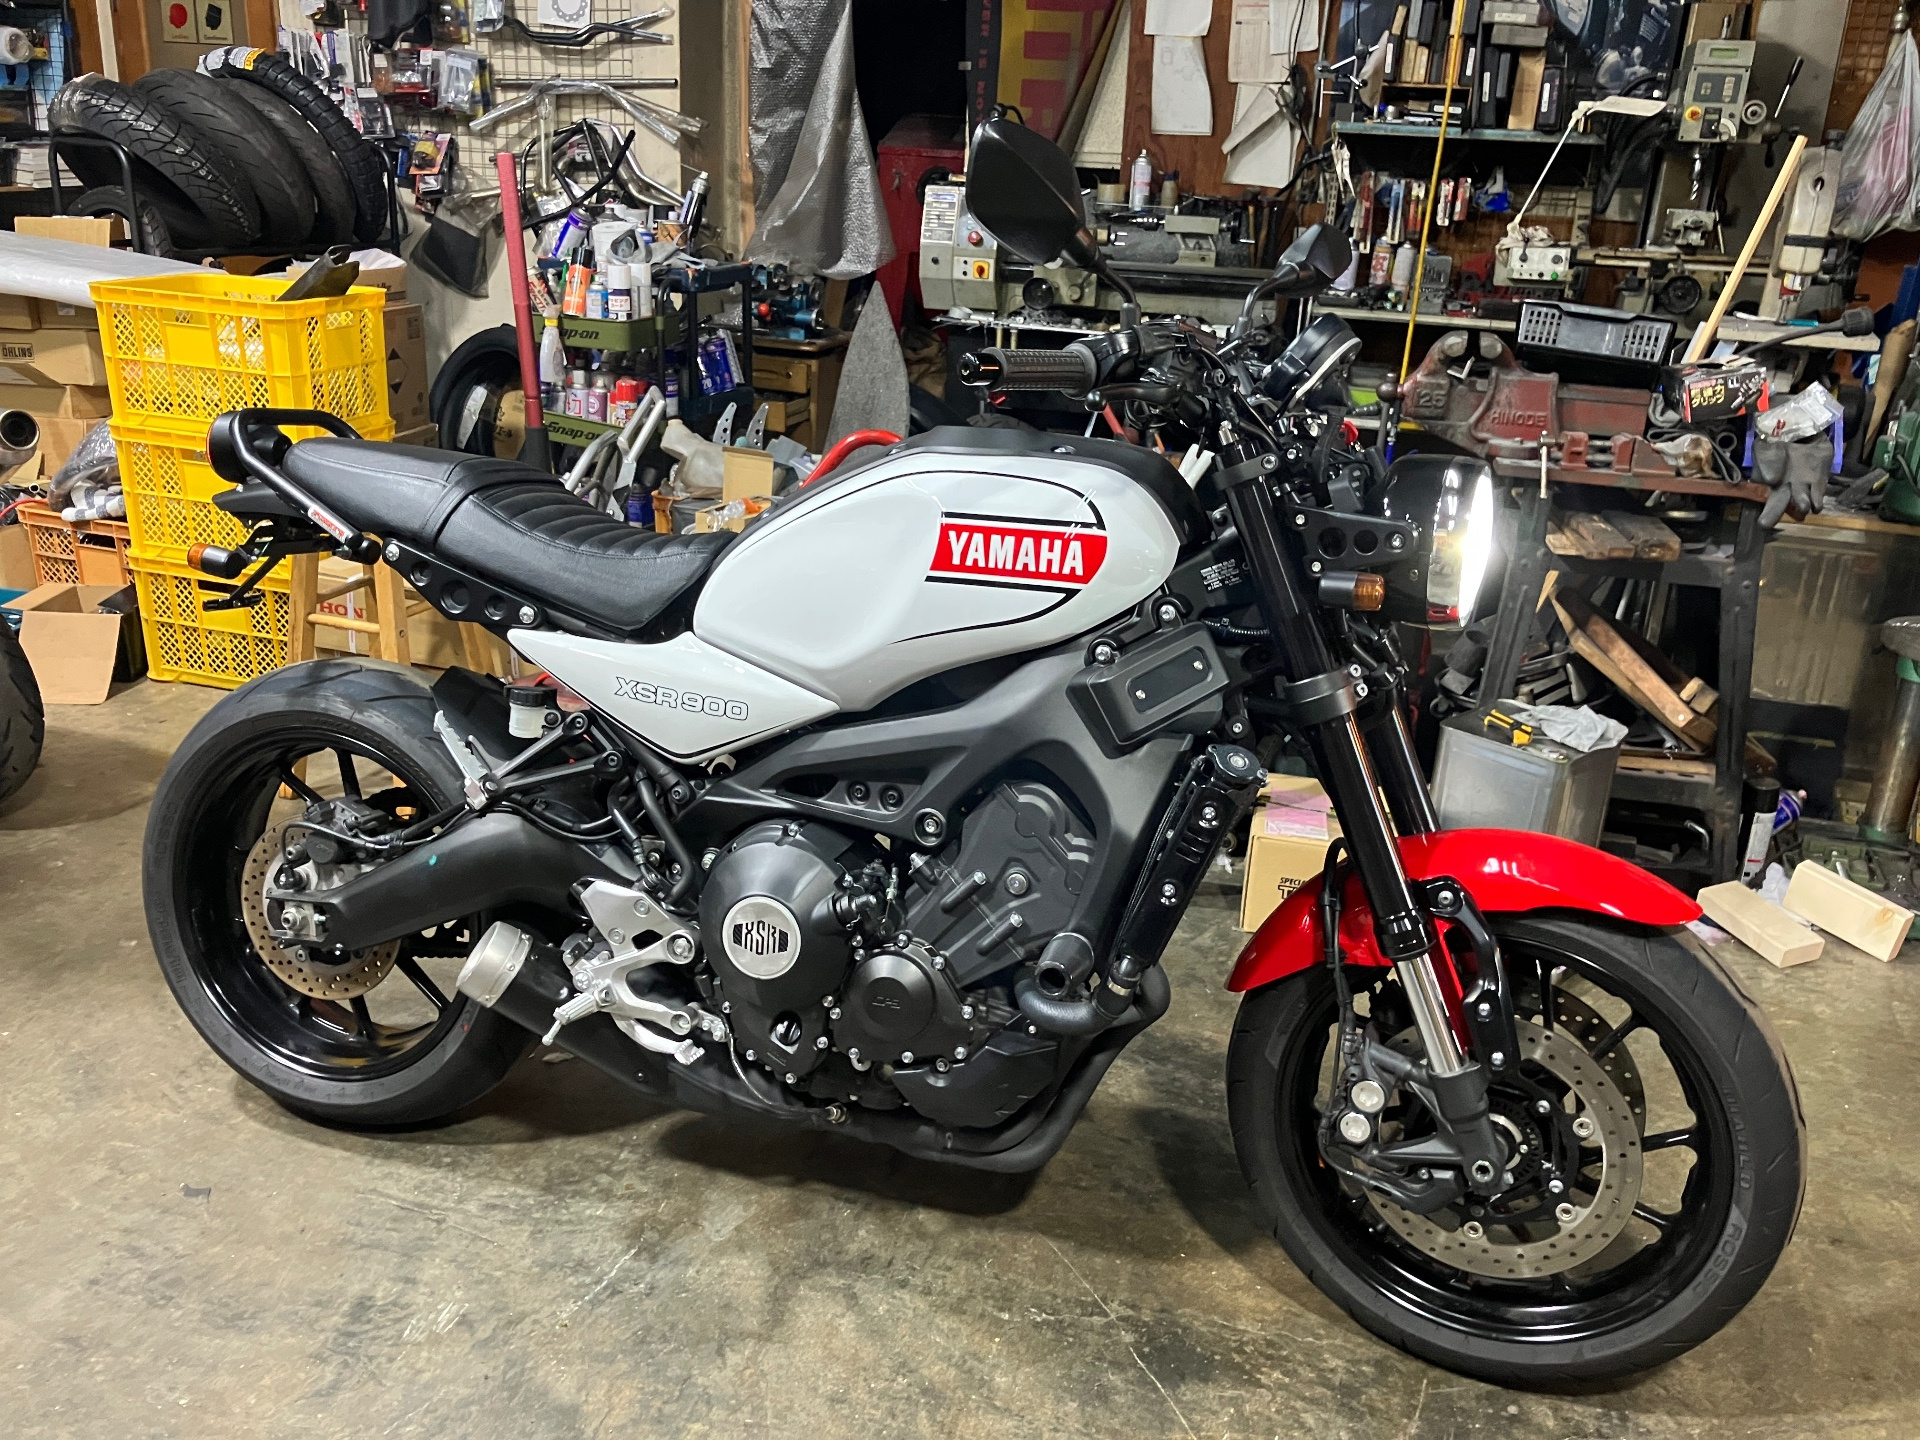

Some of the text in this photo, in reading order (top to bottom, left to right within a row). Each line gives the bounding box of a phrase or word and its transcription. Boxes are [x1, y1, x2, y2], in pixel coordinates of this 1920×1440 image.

[1490, 409, 1548, 427] HINODE
[948, 529, 1084, 576] YAMAHA
[744, 919, 777, 956] XSR
